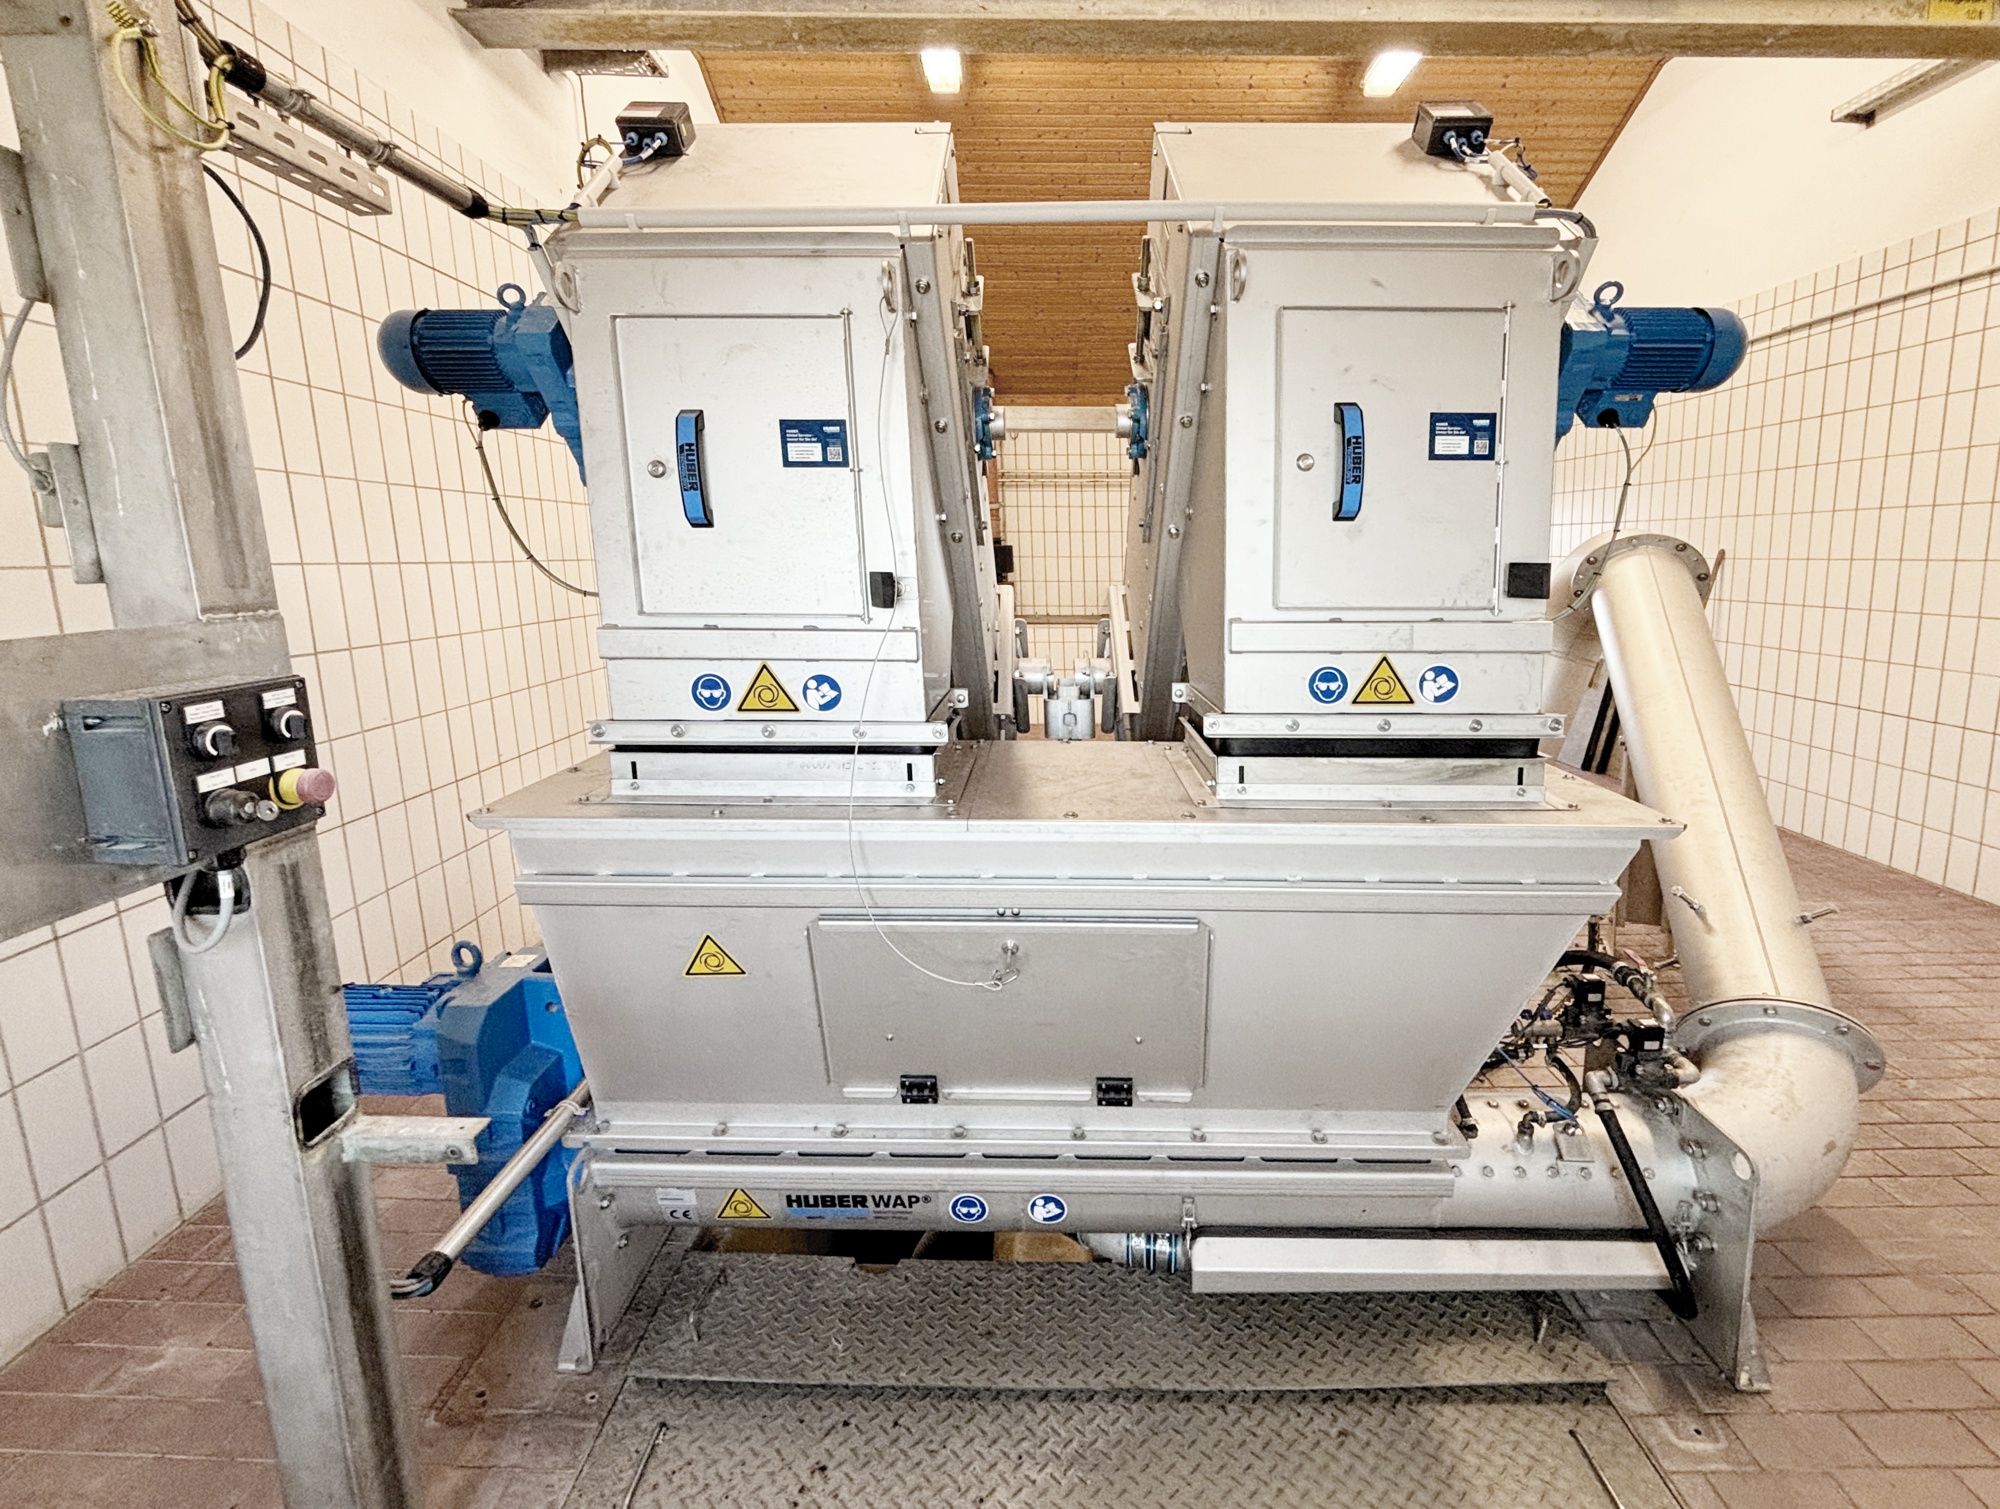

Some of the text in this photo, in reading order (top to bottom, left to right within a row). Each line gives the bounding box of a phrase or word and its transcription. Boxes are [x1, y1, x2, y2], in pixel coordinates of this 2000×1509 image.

[684, 442, 699, 491] HUBER
[1351, 435, 1362, 484] HUBER
[669, 1209, 692, 1220] CE
[786, 1194, 869, 1208] HUBER
